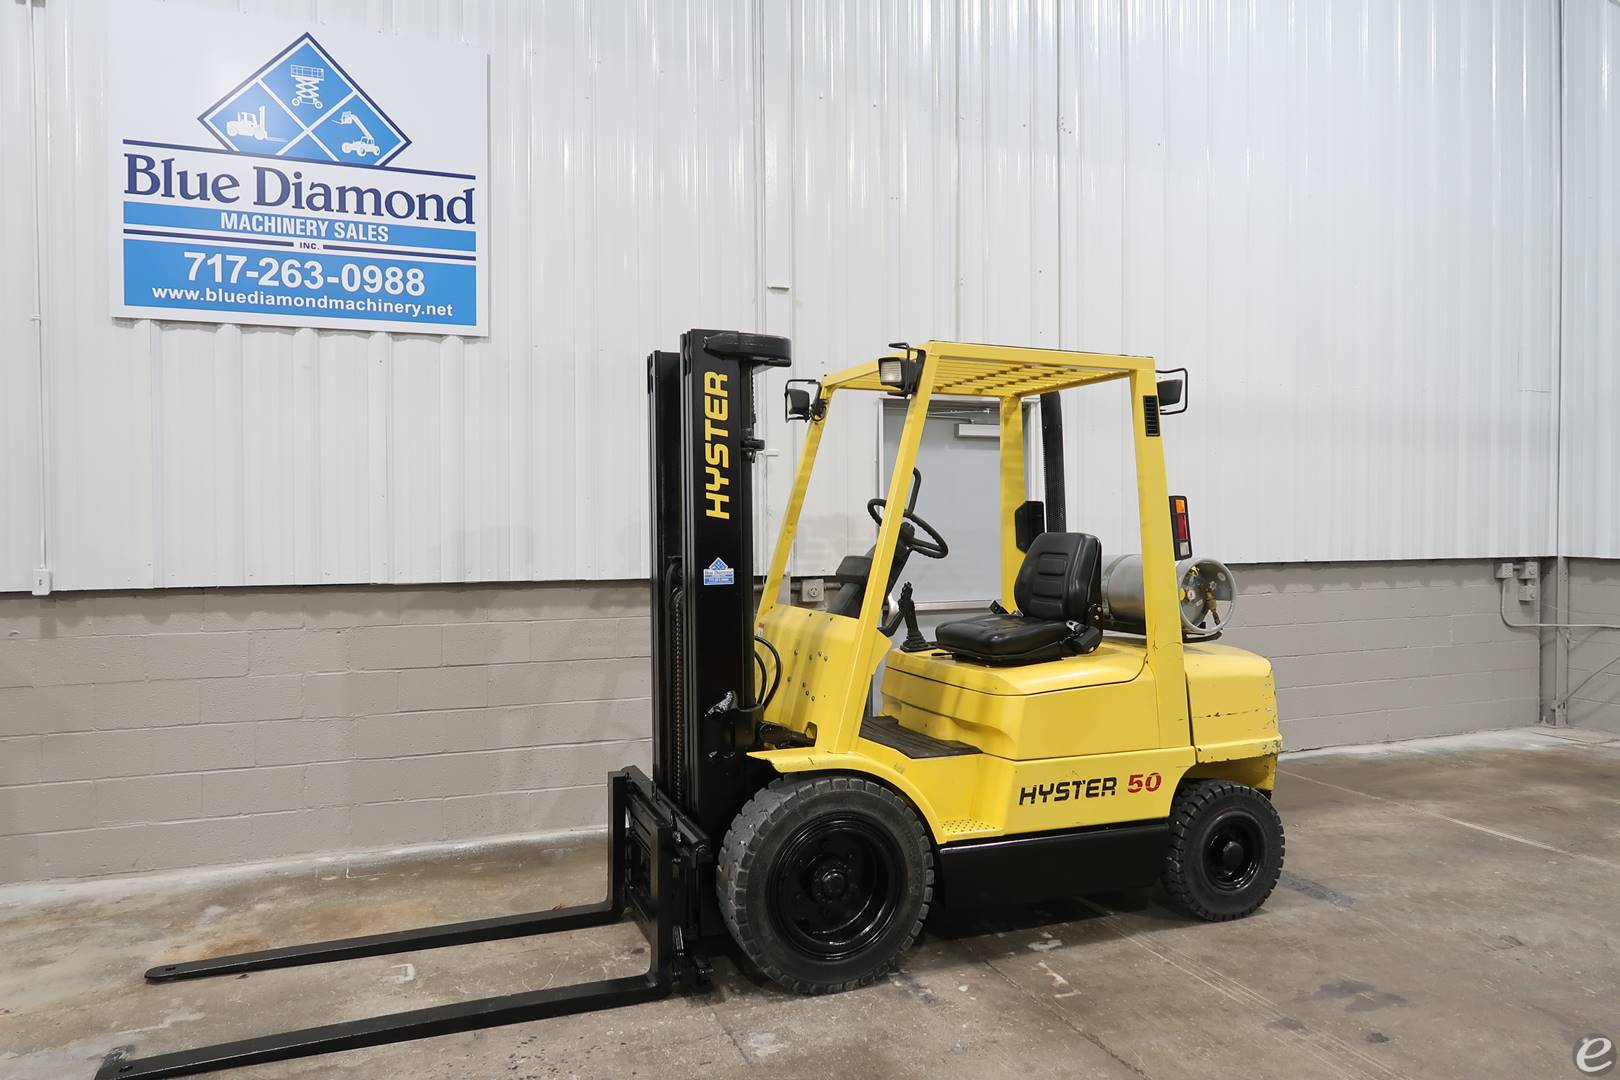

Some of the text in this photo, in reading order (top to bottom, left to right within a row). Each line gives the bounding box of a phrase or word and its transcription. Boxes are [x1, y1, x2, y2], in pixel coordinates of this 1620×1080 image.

[124, 153, 475, 224] Blue Diamond
[220, 212, 389, 242] MACHINERY SALES
[299, 242, 320, 250] INC.
[183, 251, 425, 296] 717-263-0988
[152, 287, 453, 317] www.bluediamondmachinery.net
[704, 371, 730, 520] HYSTER
[1019, 772, 1162, 805] HYSTER 50
